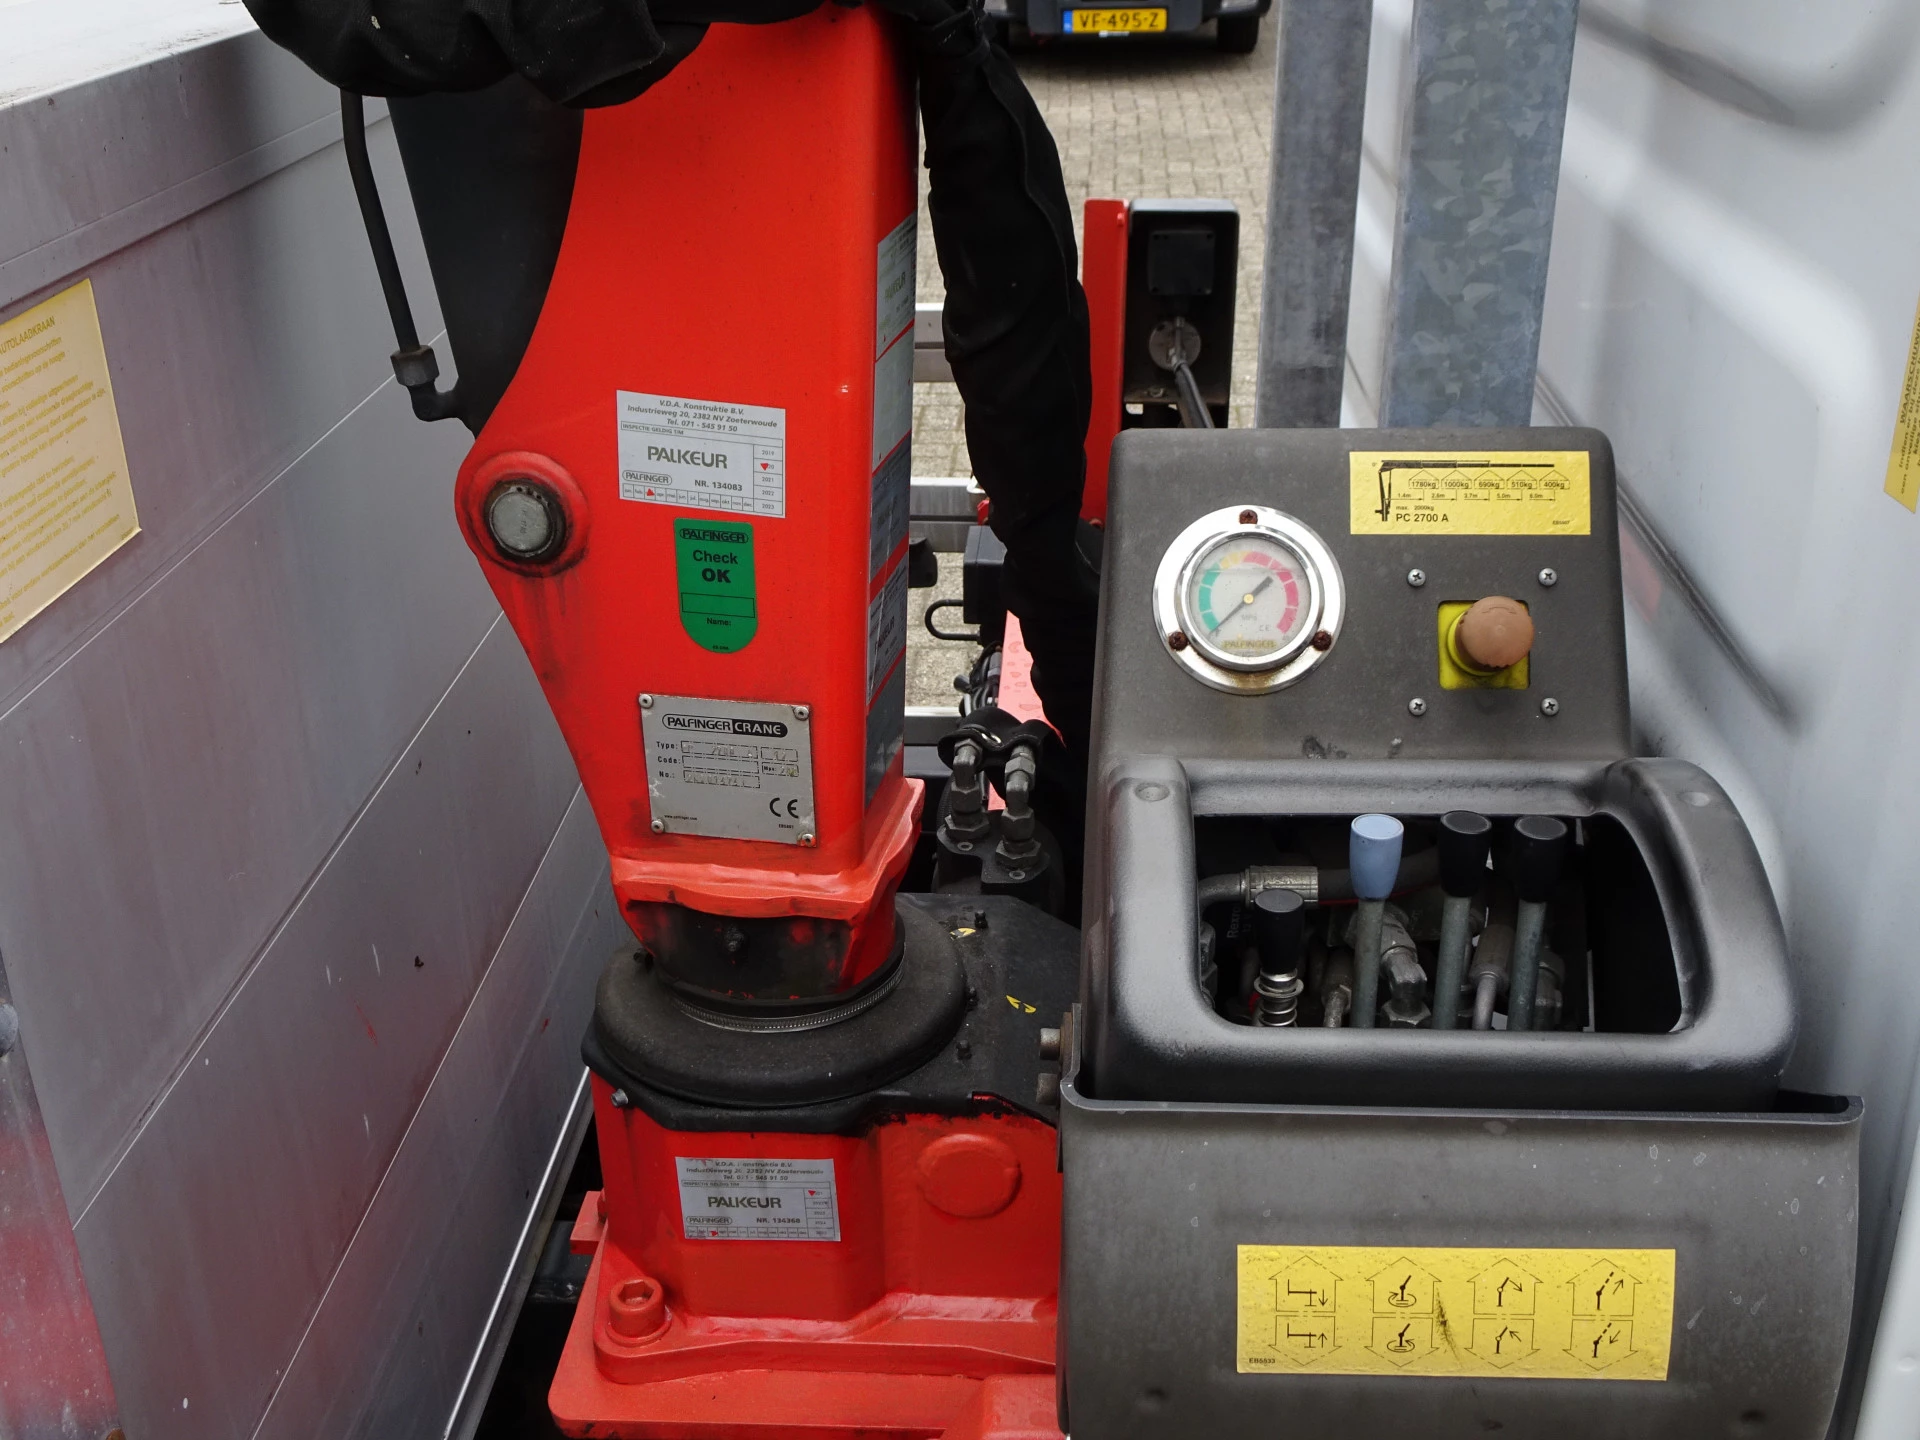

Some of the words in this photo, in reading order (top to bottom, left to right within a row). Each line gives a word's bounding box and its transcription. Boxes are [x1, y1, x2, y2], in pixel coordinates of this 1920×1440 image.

[1079, 12, 1159, 28] VF-495-Z
[659, 399, 681, 408] V.D.A.
[683, 402, 729, 413] Konstruktie
[731, 407, 744, 415] B.V.
[627, 405, 678, 418] Industrieweg
[679, 411, 690, 419] 20,
[692, 412, 711, 420] 2382
[712, 414, 724, 422] NV
[725, 415, 778, 428] Zoeterwoude
[622, 423, 650, 432] INSPECTIE
[651, 426, 673, 434] GELDIG
[667, 418, 679, 426] Tel.
[681, 420, 695, 428] 071
[701, 421, 715, 429] 545
[716, 423, 726, 431] 91
[647, 445, 728, 469] PALKEUR
[625, 471, 670, 484] PALFINGER
[694, 479, 710, 488] NR.
[712, 481, 743, 491] 134083
[1411, 480, 1437, 489] 1780kg
[1444, 481, 1469, 490] 1000kg
[1478, 481, 1500, 490] 690kg
[1511, 481, 1533, 490] 510kg
[1543, 481, 1565, 490] 400kg
[1396, 513, 1411, 522] PC
[1414, 513, 1439, 522] 2700
[1441, 513, 1449, 522] A
[681, 528, 746, 544] PALFINGER
[692, 549, 738, 565] Check
[701, 568, 731, 583] OK
[706, 617, 732, 626] Name:
[667, 716, 731, 731] PALFINGER
[734, 721, 782, 736] CRANE
[656, 741, 678, 750] Type:
[657, 755, 681, 764] Code:
[769, 797, 799, 819] CE
[707, 1196, 782, 1209] PALKEUR
[688, 1216, 731, 1224] PALFINGER
